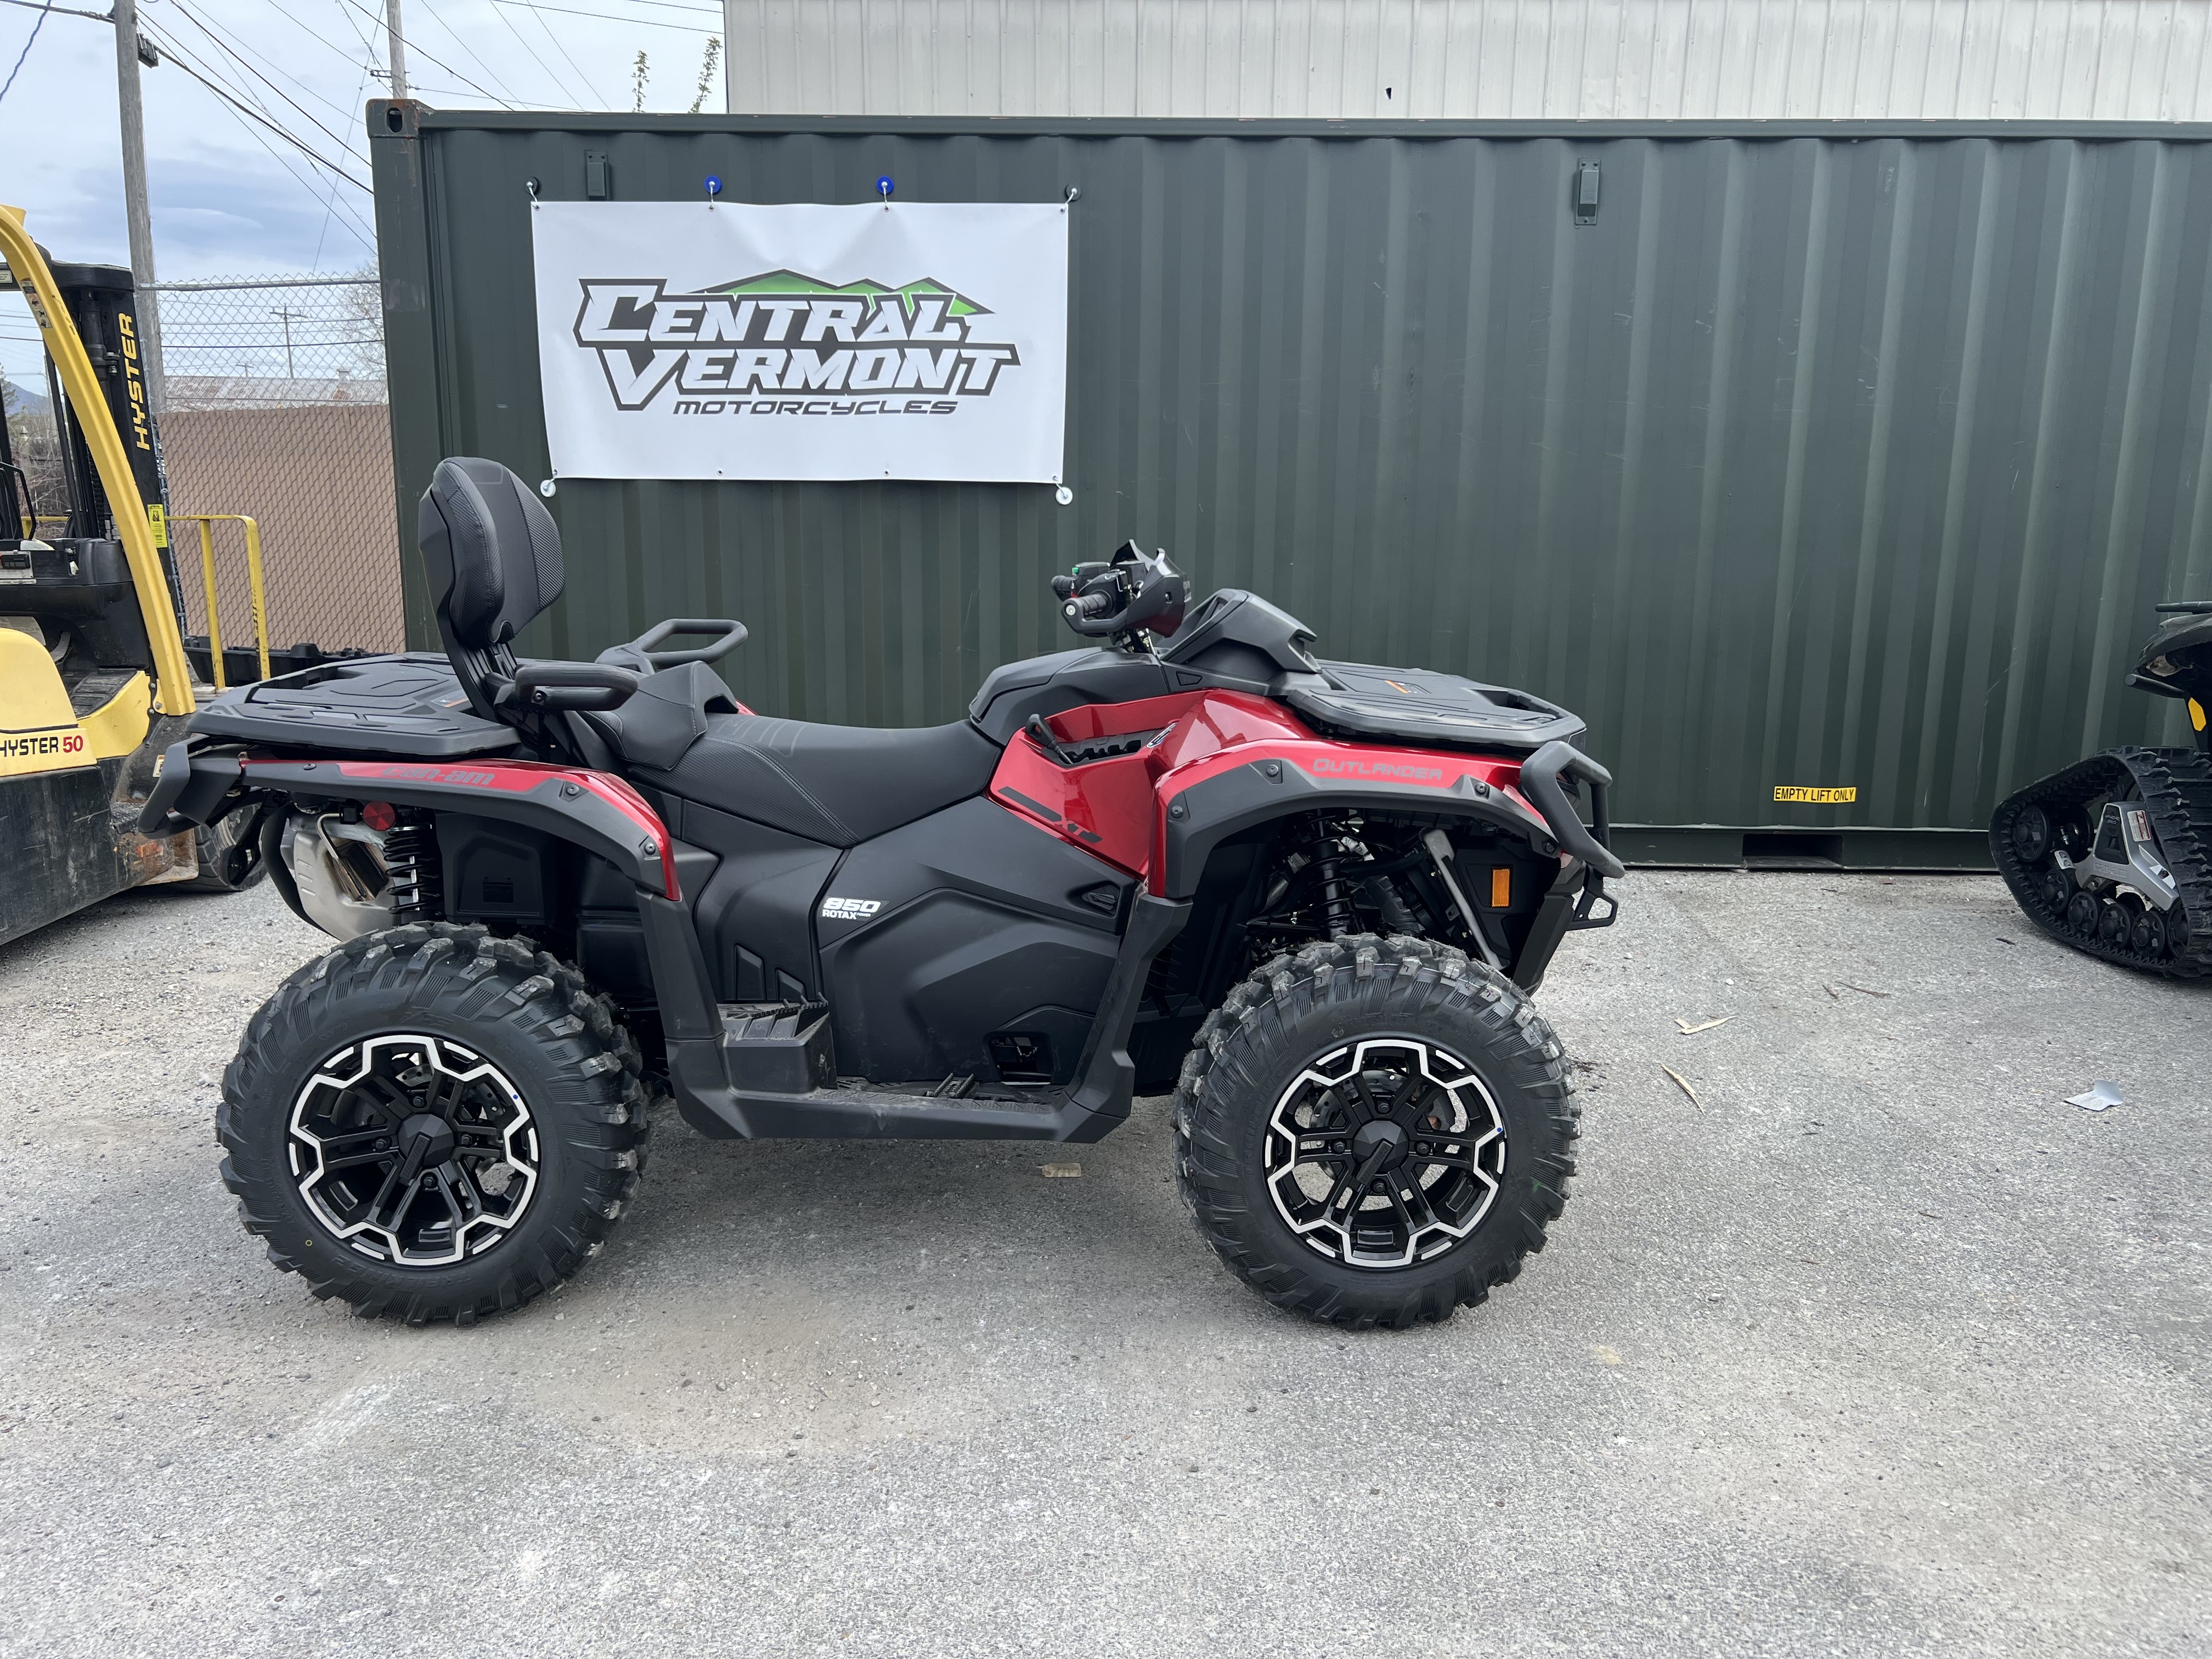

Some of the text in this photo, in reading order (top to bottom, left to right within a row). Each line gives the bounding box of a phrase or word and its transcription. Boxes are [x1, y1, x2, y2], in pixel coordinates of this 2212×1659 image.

[573, 279, 970, 346] CENTRAL
[118, 312, 150, 450] HYSTER
[596, 347, 1020, 410] VERMONT
[673, 400, 958, 415] MOTORCYCLES
[63, 735, 83, 753] 50
[382, 766, 495, 785] can-am
[1313, 758, 1443, 781] OUTLANDER
[1775, 788, 1854, 802] EMPTY LIFT ONLY
[1053, 814, 1091, 837] XT
[822, 909, 857, 919] ROTAX
[823, 898, 881, 913] 850
